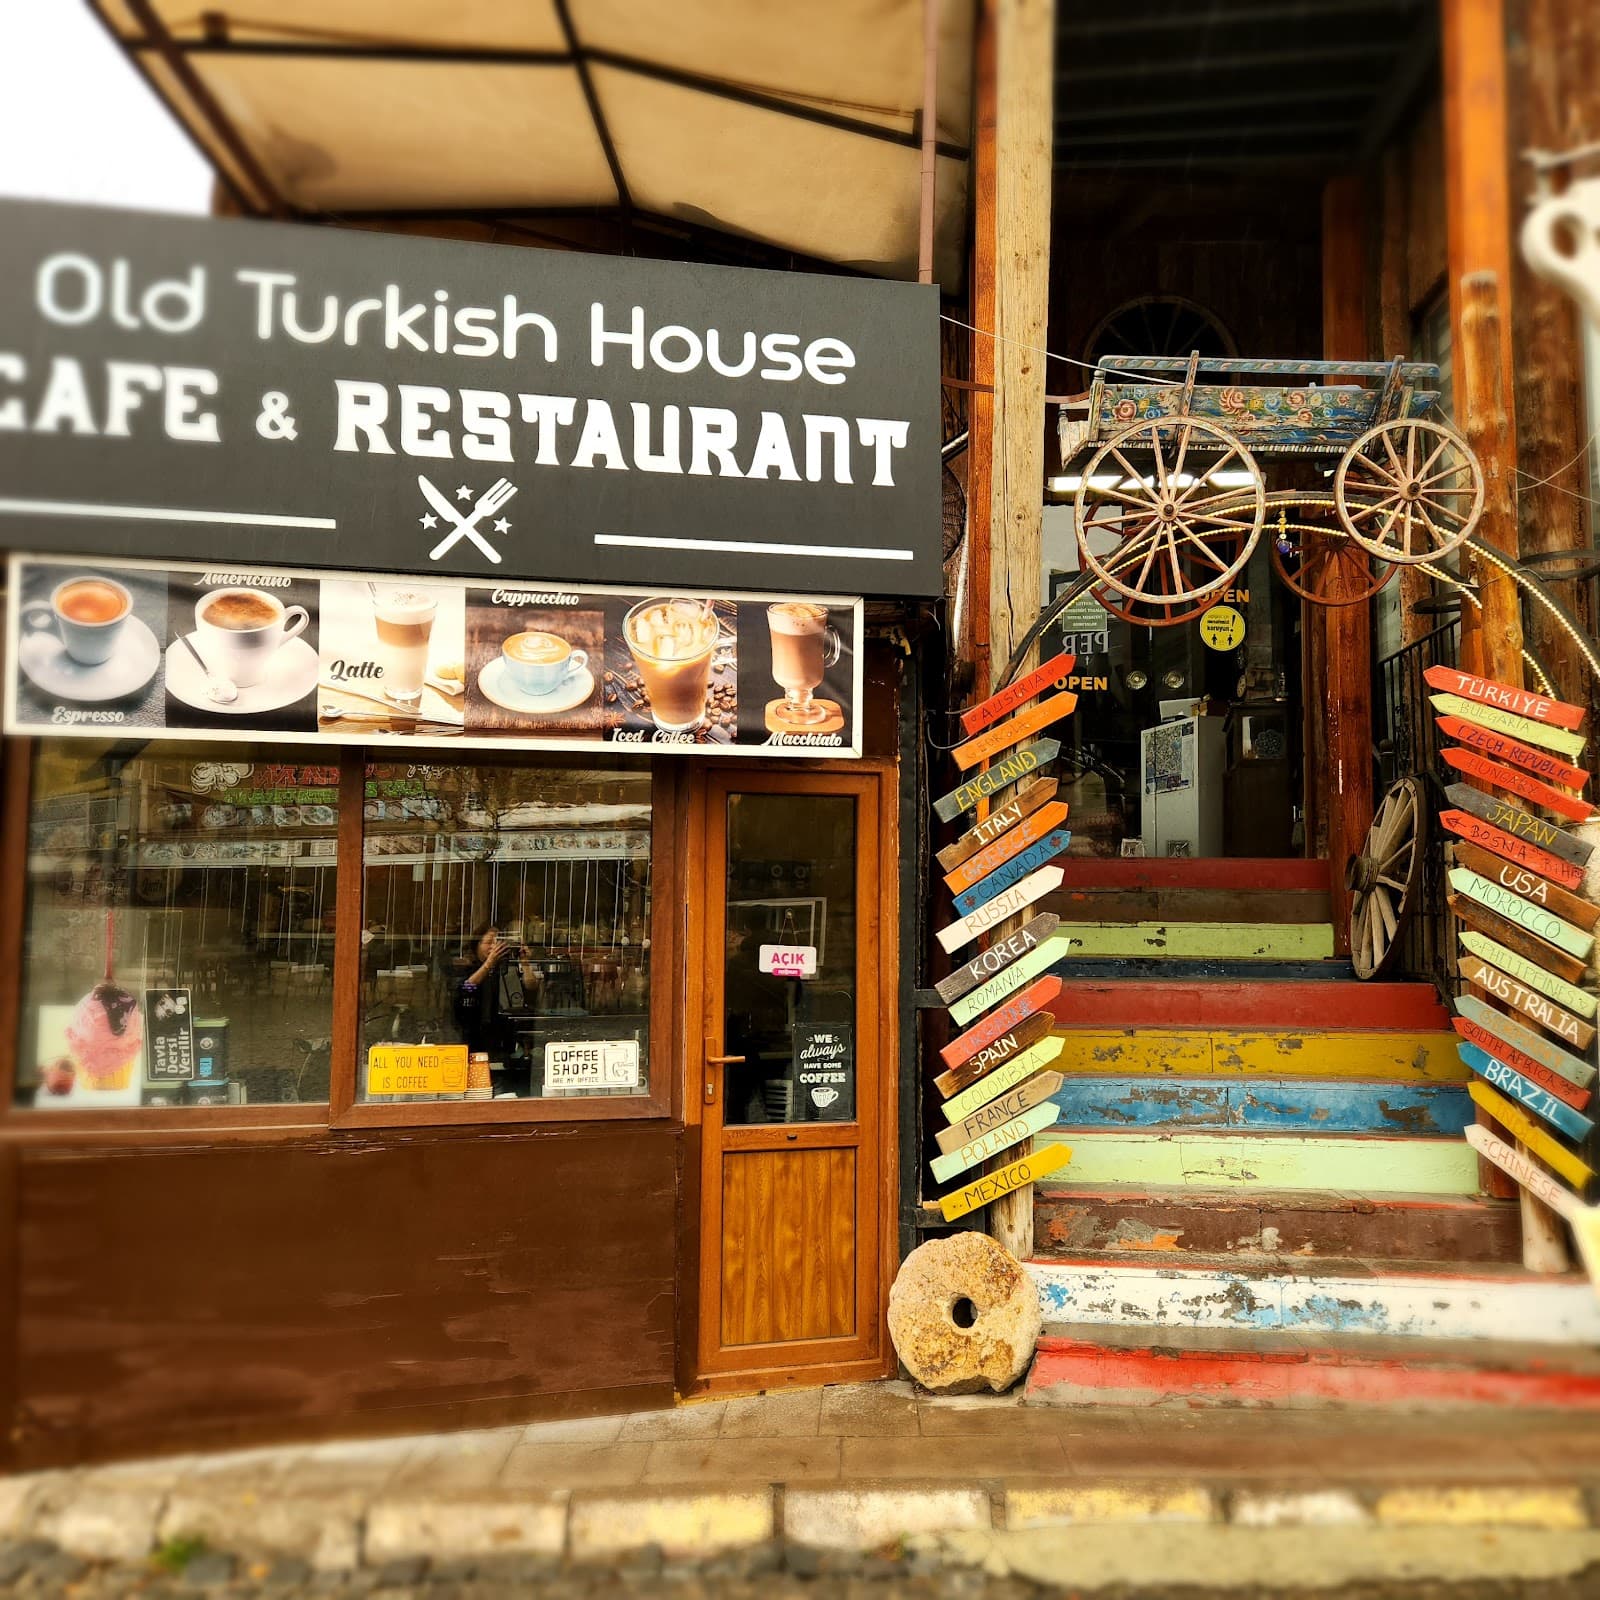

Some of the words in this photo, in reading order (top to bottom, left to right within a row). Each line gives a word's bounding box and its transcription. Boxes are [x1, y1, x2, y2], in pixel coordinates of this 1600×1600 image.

[36, 252, 207, 333] Old
[235, 268, 558, 363] Turkish
[590, 301, 857, 386] House
[255, 390, 299, 441] &
[333, 378, 911, 487] RESTAURANT
[194, 572, 293, 589] Americano
[490, 588, 580, 607] Cappuccino
[329, 659, 385, 682] Latte
[1053, 675, 1108, 691] OPEN
[51, 705, 126, 725] Espresso
[981, 672, 1045, 720] AUSTRIA
[611, 727, 645, 744] Iced
[651, 728, 696, 745] Coffee
[760, 731, 844, 747] Macchiato
[1457, 724, 1505, 752] CZECH
[1508, 745, 1573, 782] REPUBLIC
[954, 750, 1038, 811] ENGLAND
[1486, 804, 1558, 845] JAPAN
[977, 844, 1050, 899] CANADA
[1500, 865, 1549, 903] USA
[964, 888, 1026, 935] RUSSIA
[1468, 877, 1562, 939] MOROCCO
[771, 952, 805, 966] AÇIK
[968, 929, 1037, 981] KOREA
[155, 1035, 166, 1074] Tavla
[166, 1037, 178, 1075] Dersi
[178, 1027, 190, 1075] Verilir
[553, 1049, 599, 1062] COFFEE
[799, 1043, 847, 1060] always
[813, 1034, 833, 1044] WE
[1464, 1022, 1505, 1051] SOUTH
[1508, 1050, 1556, 1088] AFRICA
[373, 1056, 388, 1069] ALL
[396, 1056, 412, 1069] YOU
[418, 1055, 439, 1068] NEED
[552, 1063, 598, 1076] SHOPS
[799, 1072, 846, 1083] COFFEE
[823, 1061, 842, 1069] SOME
[382, 1076, 391, 1089] IS
[396, 1075, 429, 1088] COFFEE
[960, 1120, 1029, 1169] POLAND
[1486, 1139, 1563, 1205] CHINESE
